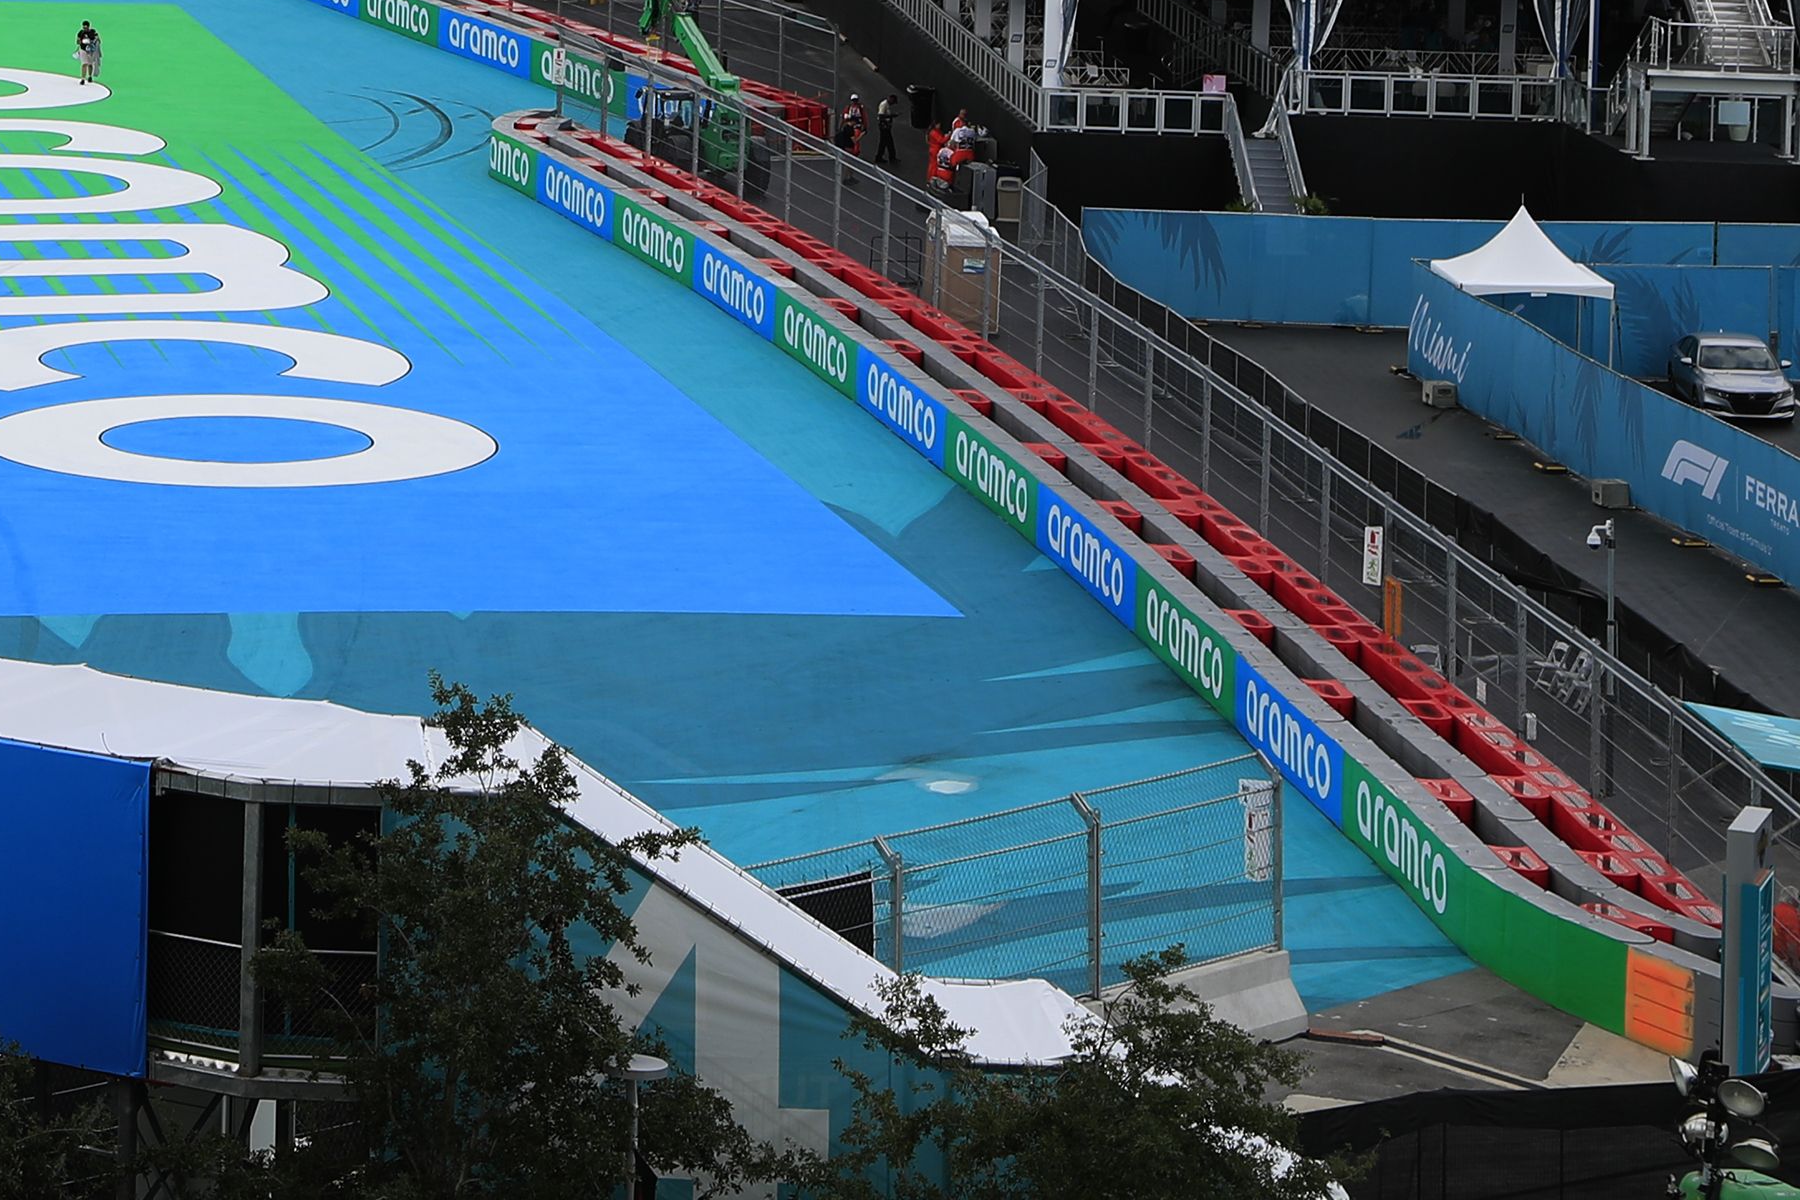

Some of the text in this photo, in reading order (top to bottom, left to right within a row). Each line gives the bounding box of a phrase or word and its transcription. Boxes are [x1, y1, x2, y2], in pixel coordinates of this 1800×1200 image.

[449, 18, 519, 68] aramco
[546, 166, 605, 227] aramco
[622, 205, 685, 275] aramco
[703, 252, 765, 326] aramco
[783, 300, 848, 384] aramco
[1408, 294, 1473, 384] Miami
[867, 360, 936, 451] aramco
[955, 430, 1029, 523] aramco
[1745, 475, 1800, 528] FERRA
[1046, 502, 1125, 608] aramco
[1145, 597, 1225, 703] aramco
[1245, 678, 1331, 800] aramco
[1355, 777, 1448, 915] aramco
